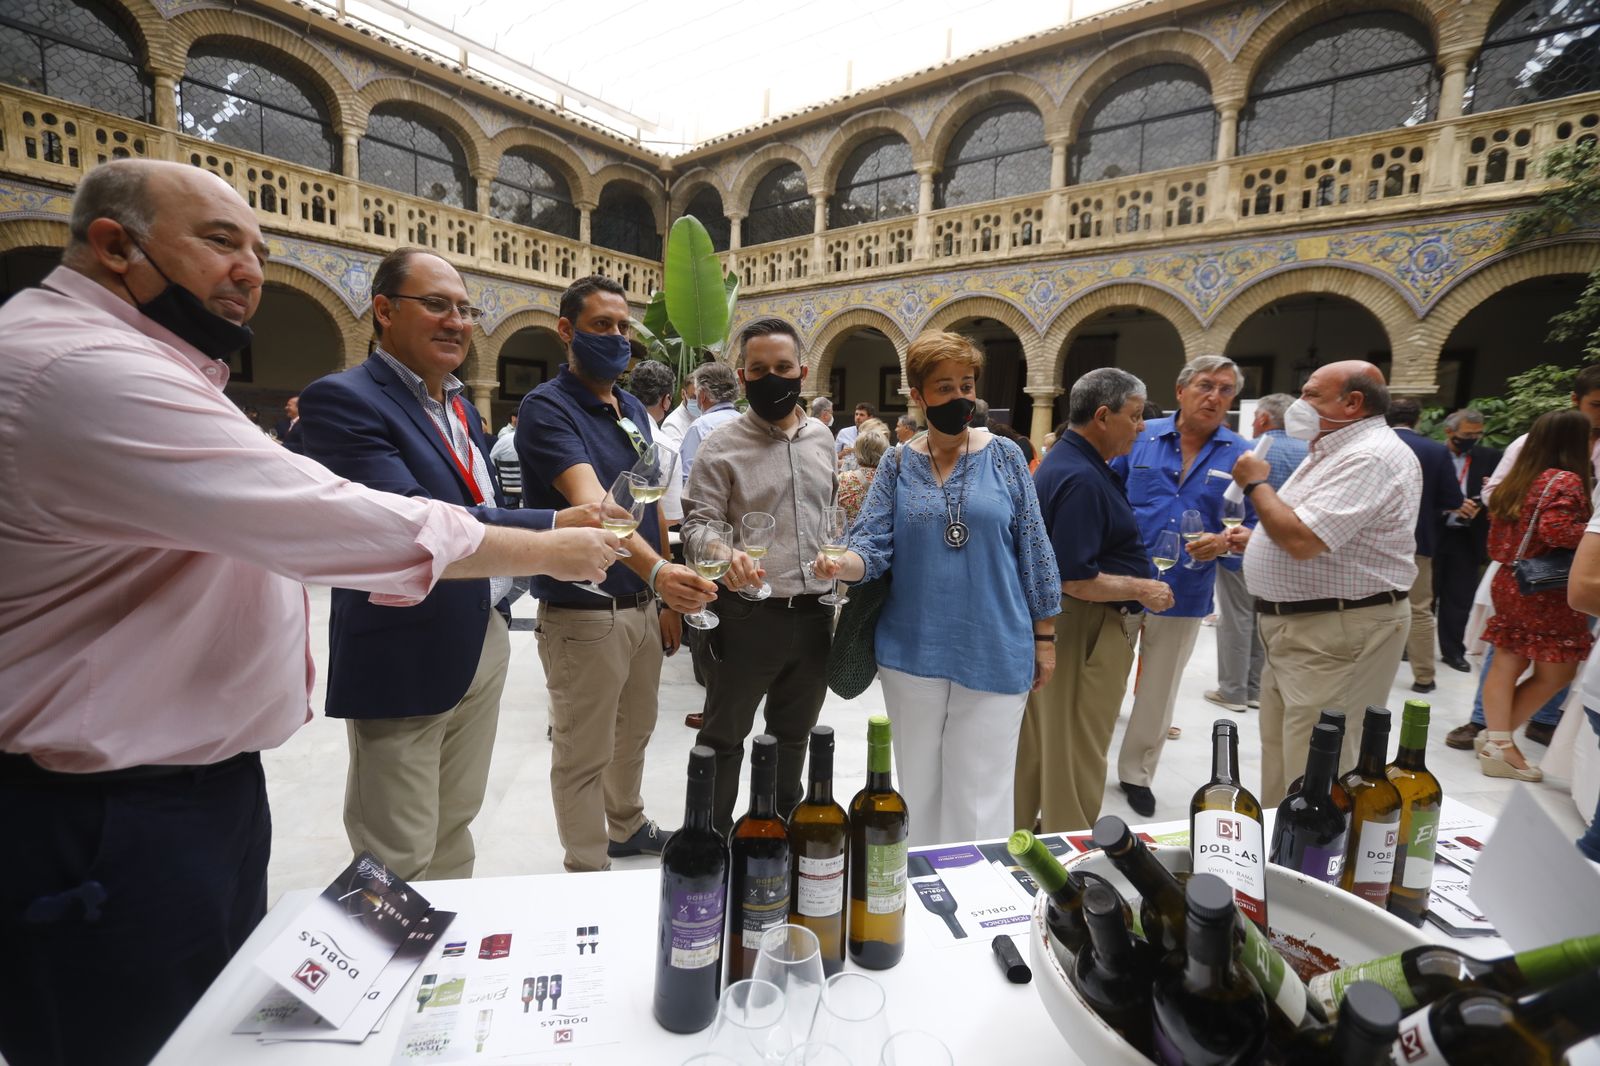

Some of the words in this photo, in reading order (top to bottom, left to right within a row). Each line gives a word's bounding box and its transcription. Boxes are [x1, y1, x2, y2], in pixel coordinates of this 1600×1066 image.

[971, 905, 1016, 917] DOBLAS
[299, 931, 360, 980] DOBLAS
[540, 1016, 588, 1027] DOBLAS
